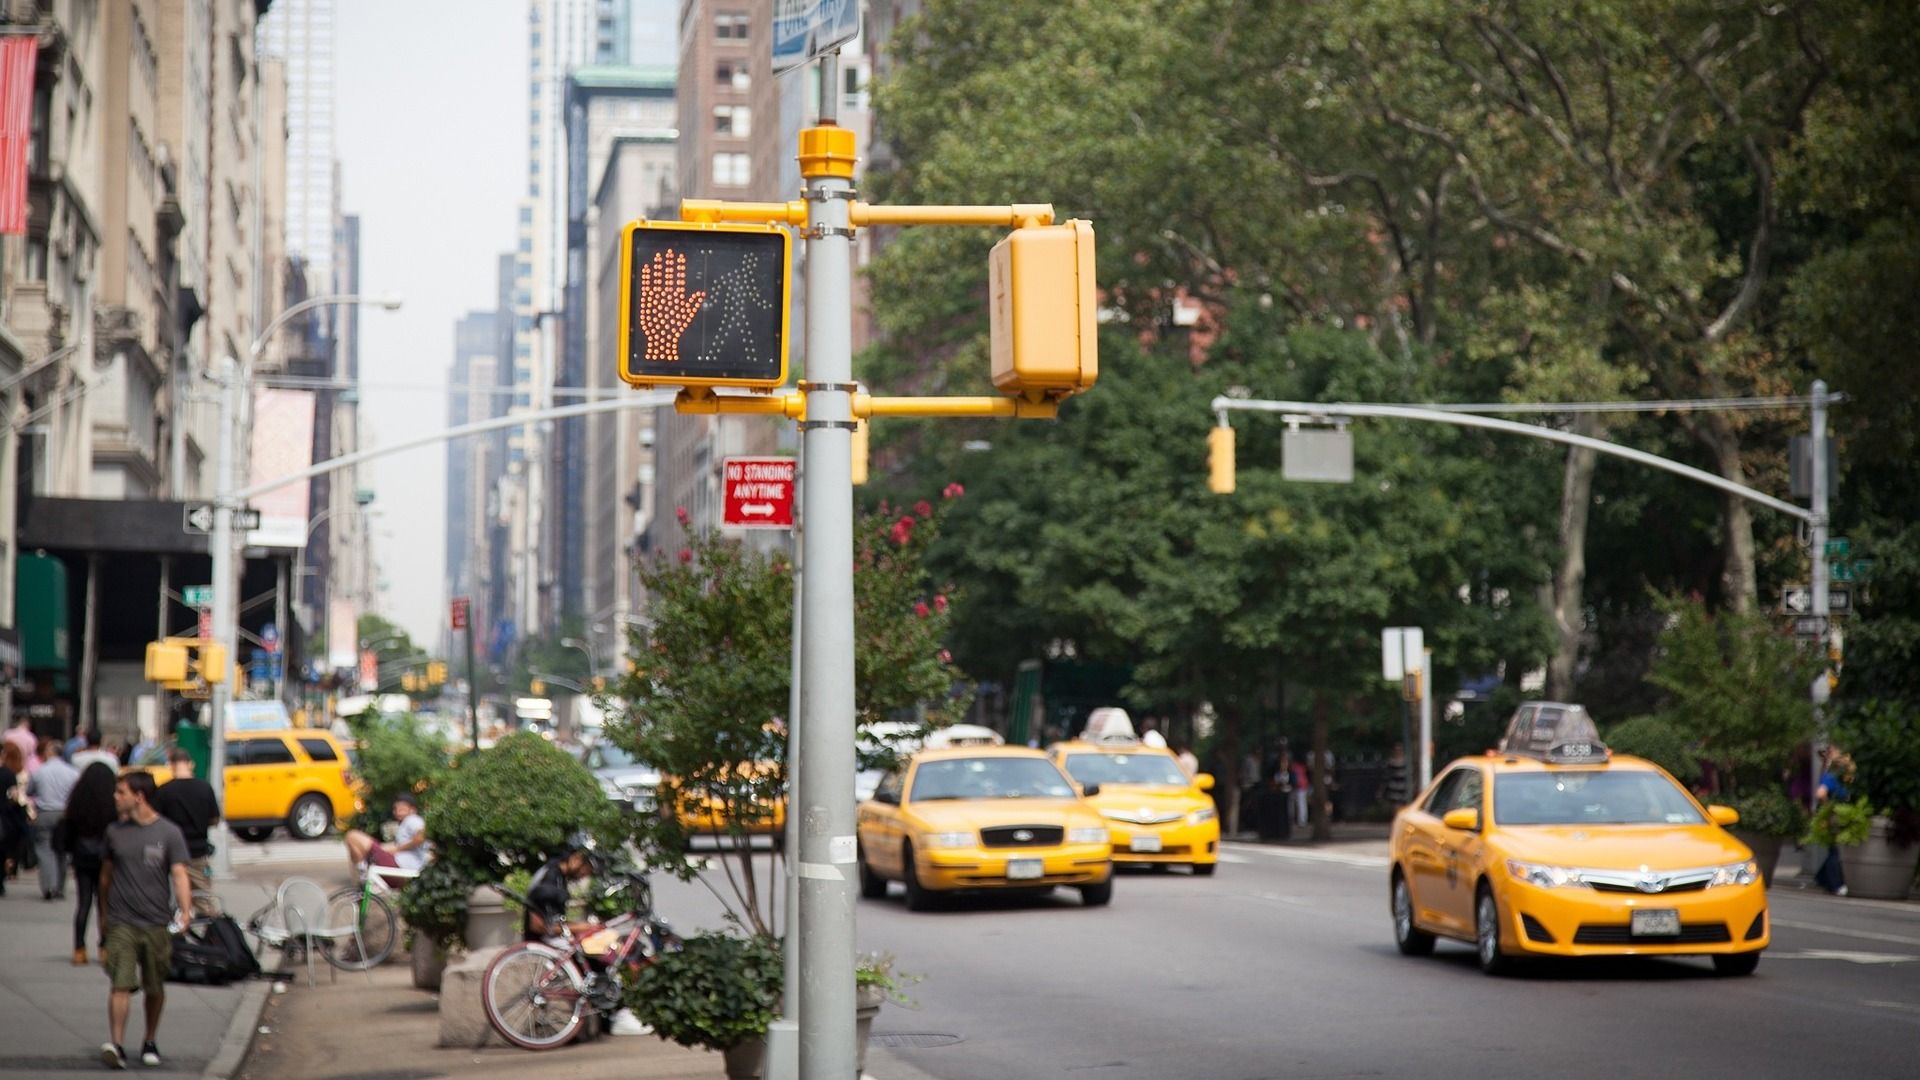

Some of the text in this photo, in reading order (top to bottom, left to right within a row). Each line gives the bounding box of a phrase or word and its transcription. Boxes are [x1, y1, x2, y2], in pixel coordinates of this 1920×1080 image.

[727, 464, 794, 481] NO STANDING
[733, 483, 785, 499] ANYTIME
